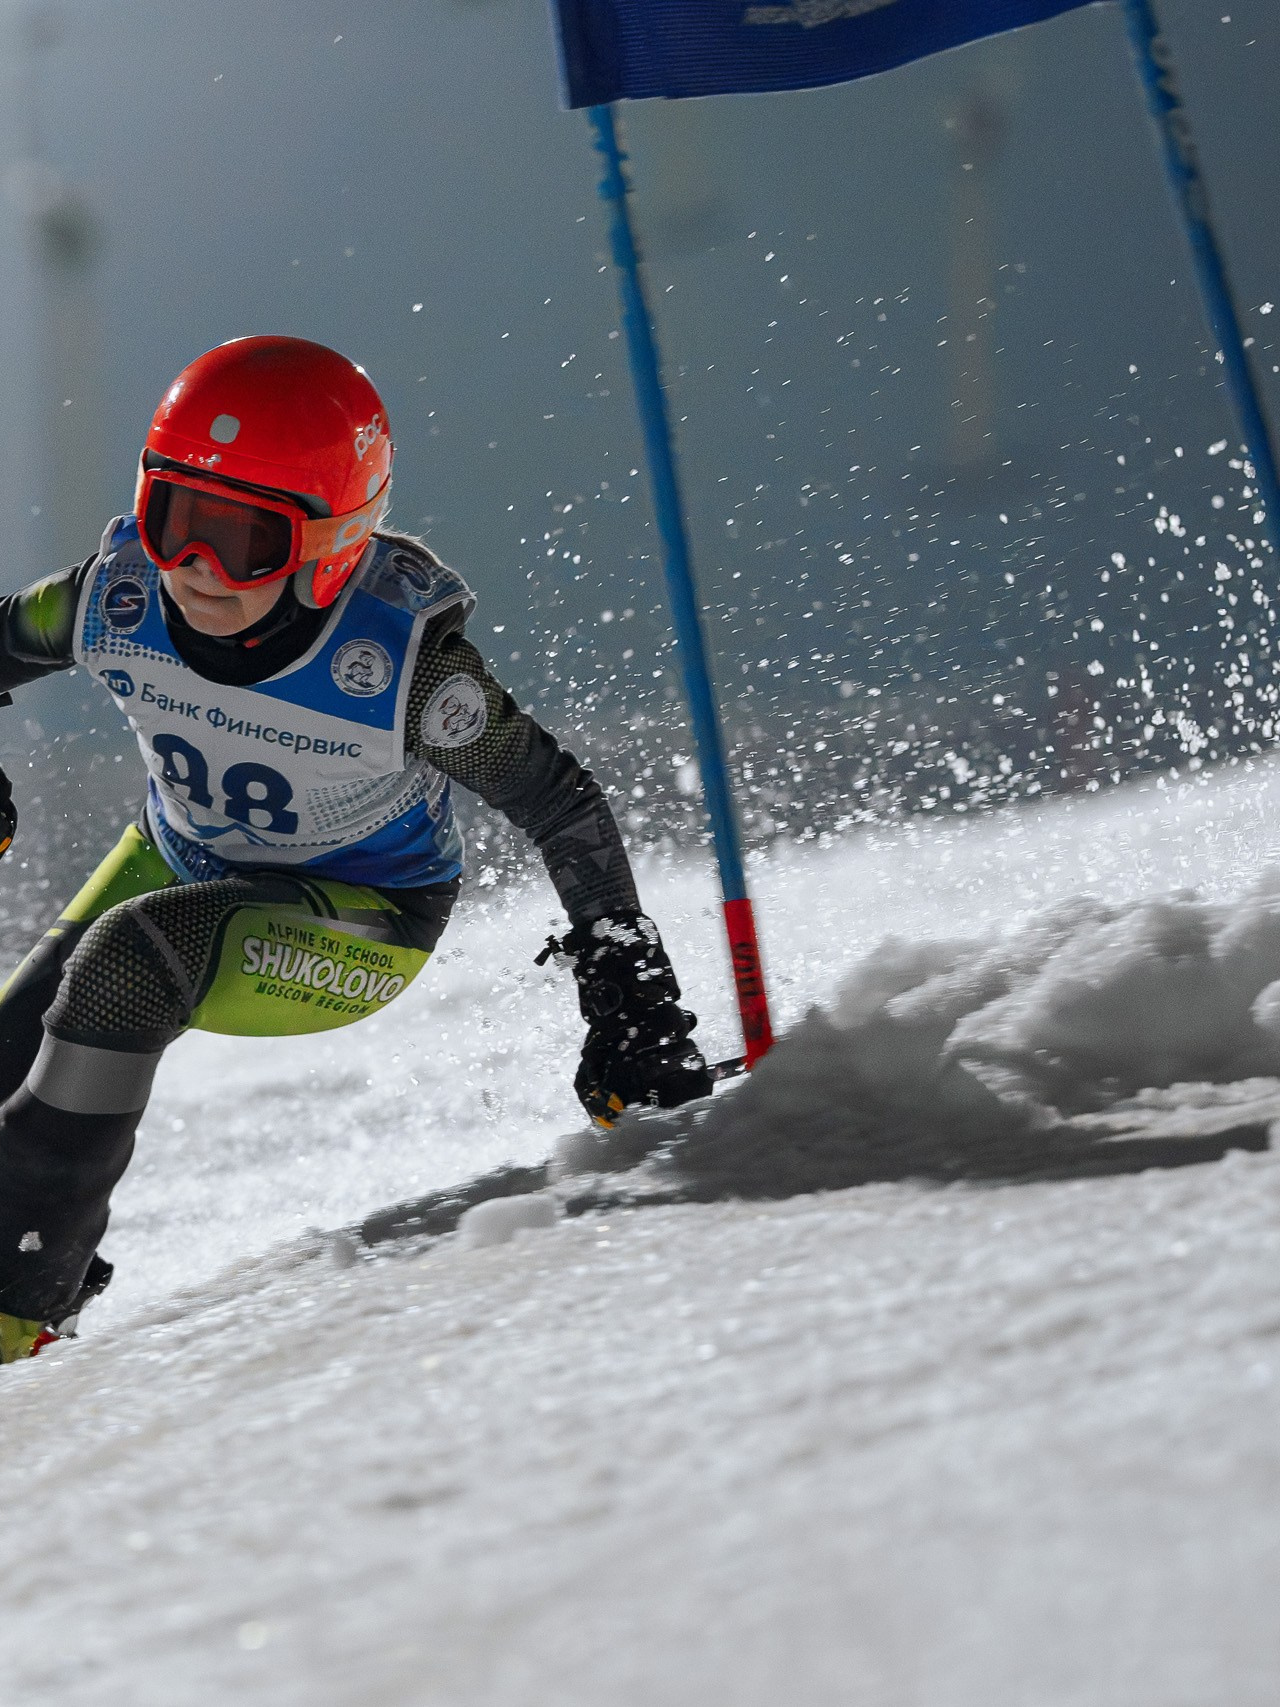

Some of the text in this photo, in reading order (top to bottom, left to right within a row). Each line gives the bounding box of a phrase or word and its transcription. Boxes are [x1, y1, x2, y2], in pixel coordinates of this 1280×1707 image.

[141, 683, 362, 757] Банк Финсервис
[241, 935, 406, 1003] SHUKOLOVO
[268, 922, 393, 969] ALPINE SKI SCHOOL
[255, 981, 371, 1014] MOSCOW REGION
